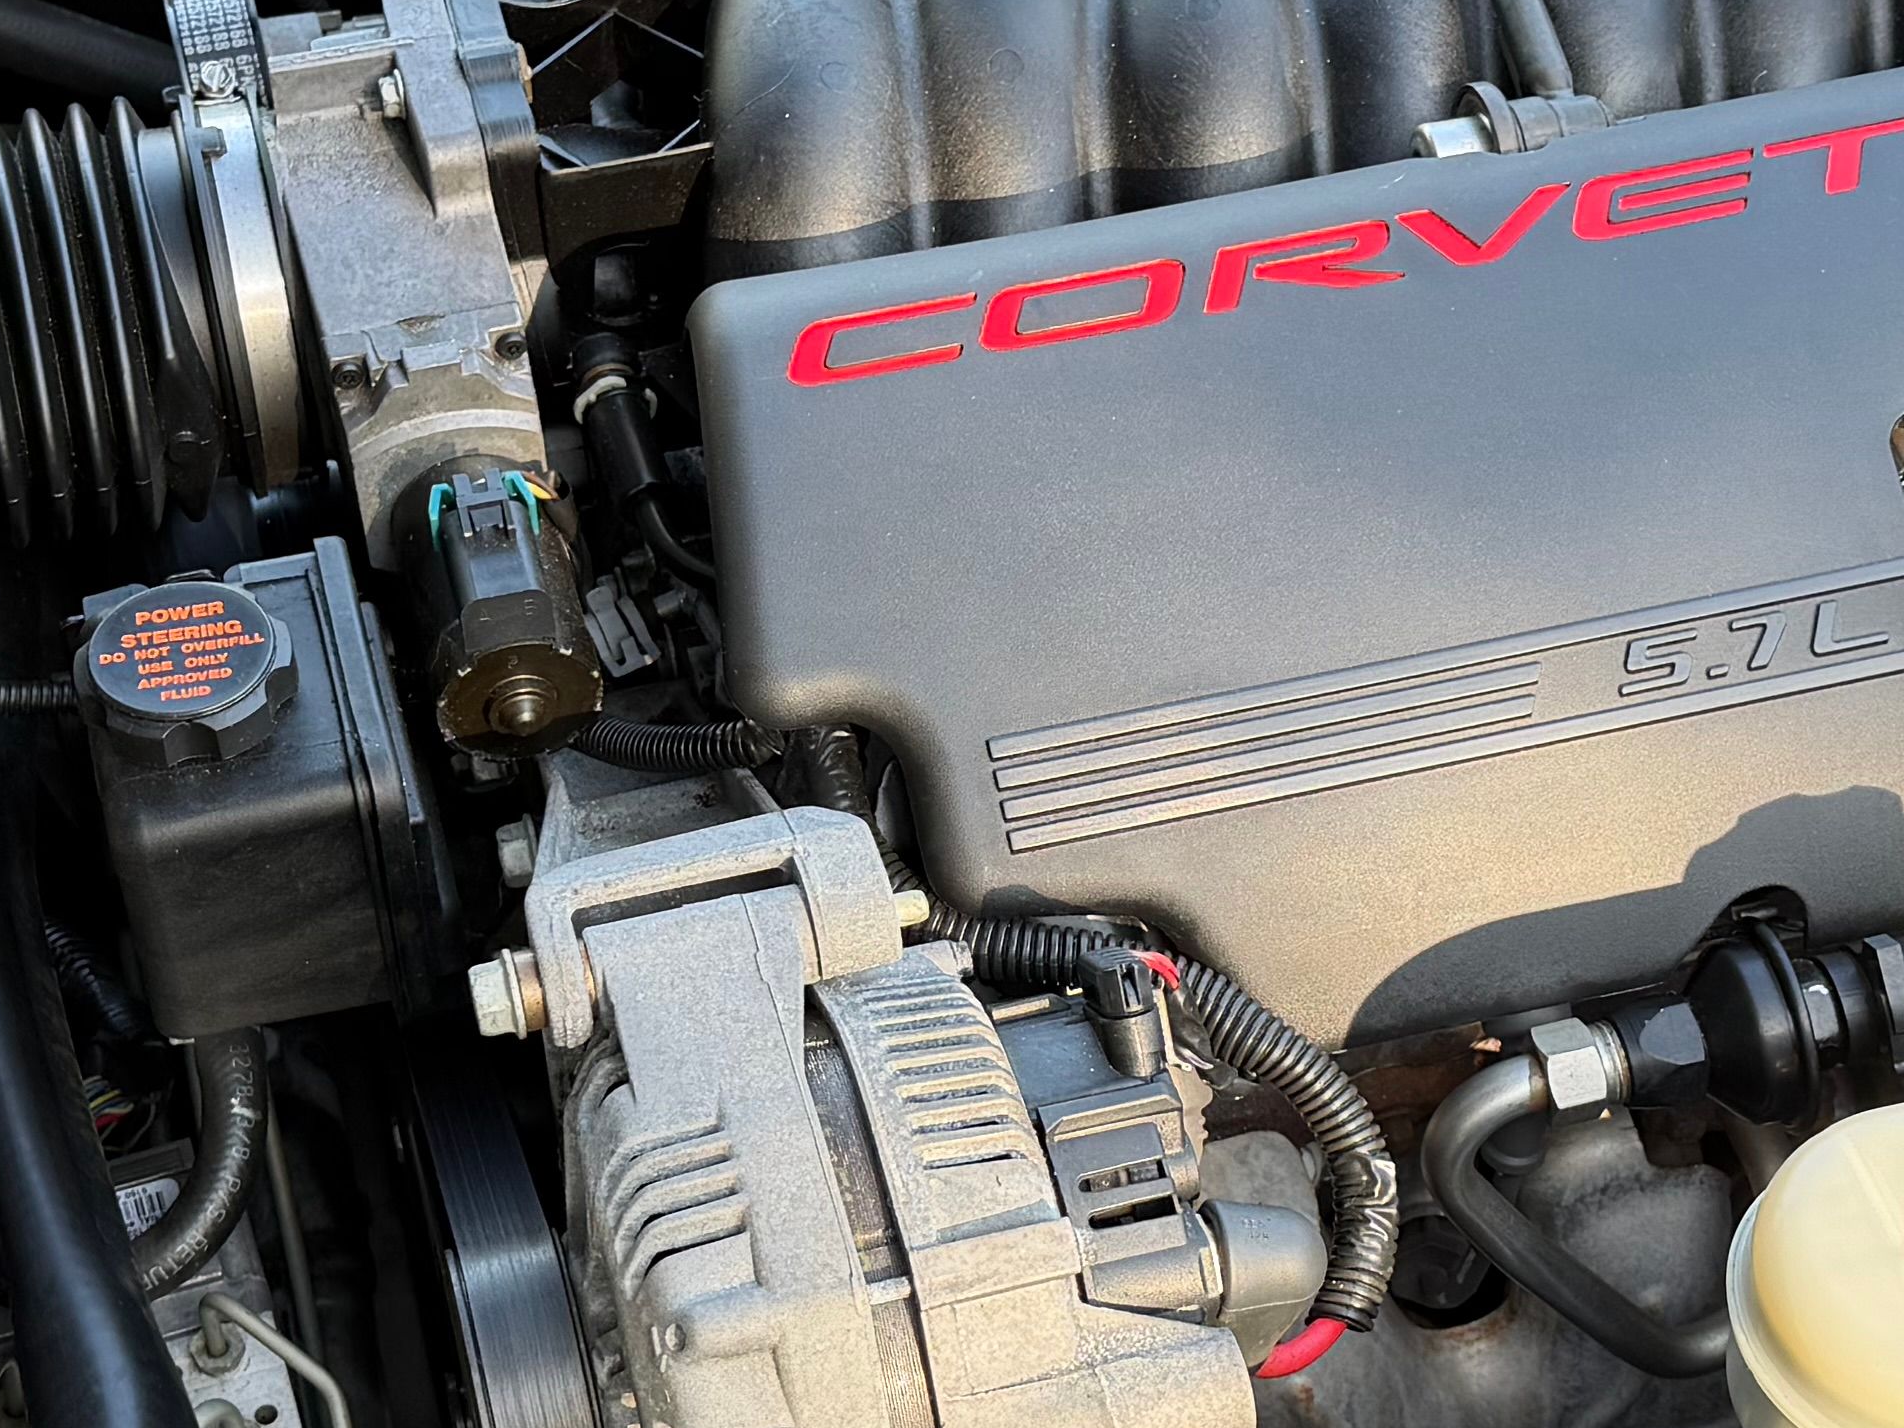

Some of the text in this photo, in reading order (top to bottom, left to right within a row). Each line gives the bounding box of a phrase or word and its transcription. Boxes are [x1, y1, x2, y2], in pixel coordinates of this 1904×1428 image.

[135, 601, 225, 626] POWER
[120, 620, 243, 648] STEERING
[99, 632, 265, 665] DO NOT OVERFILL
[1618, 600, 1889, 698] 5.7L
[138, 652, 229, 675] USE ONLY
[137, 667, 233, 690] APPROVED
[160, 685, 212, 701] FLUID
